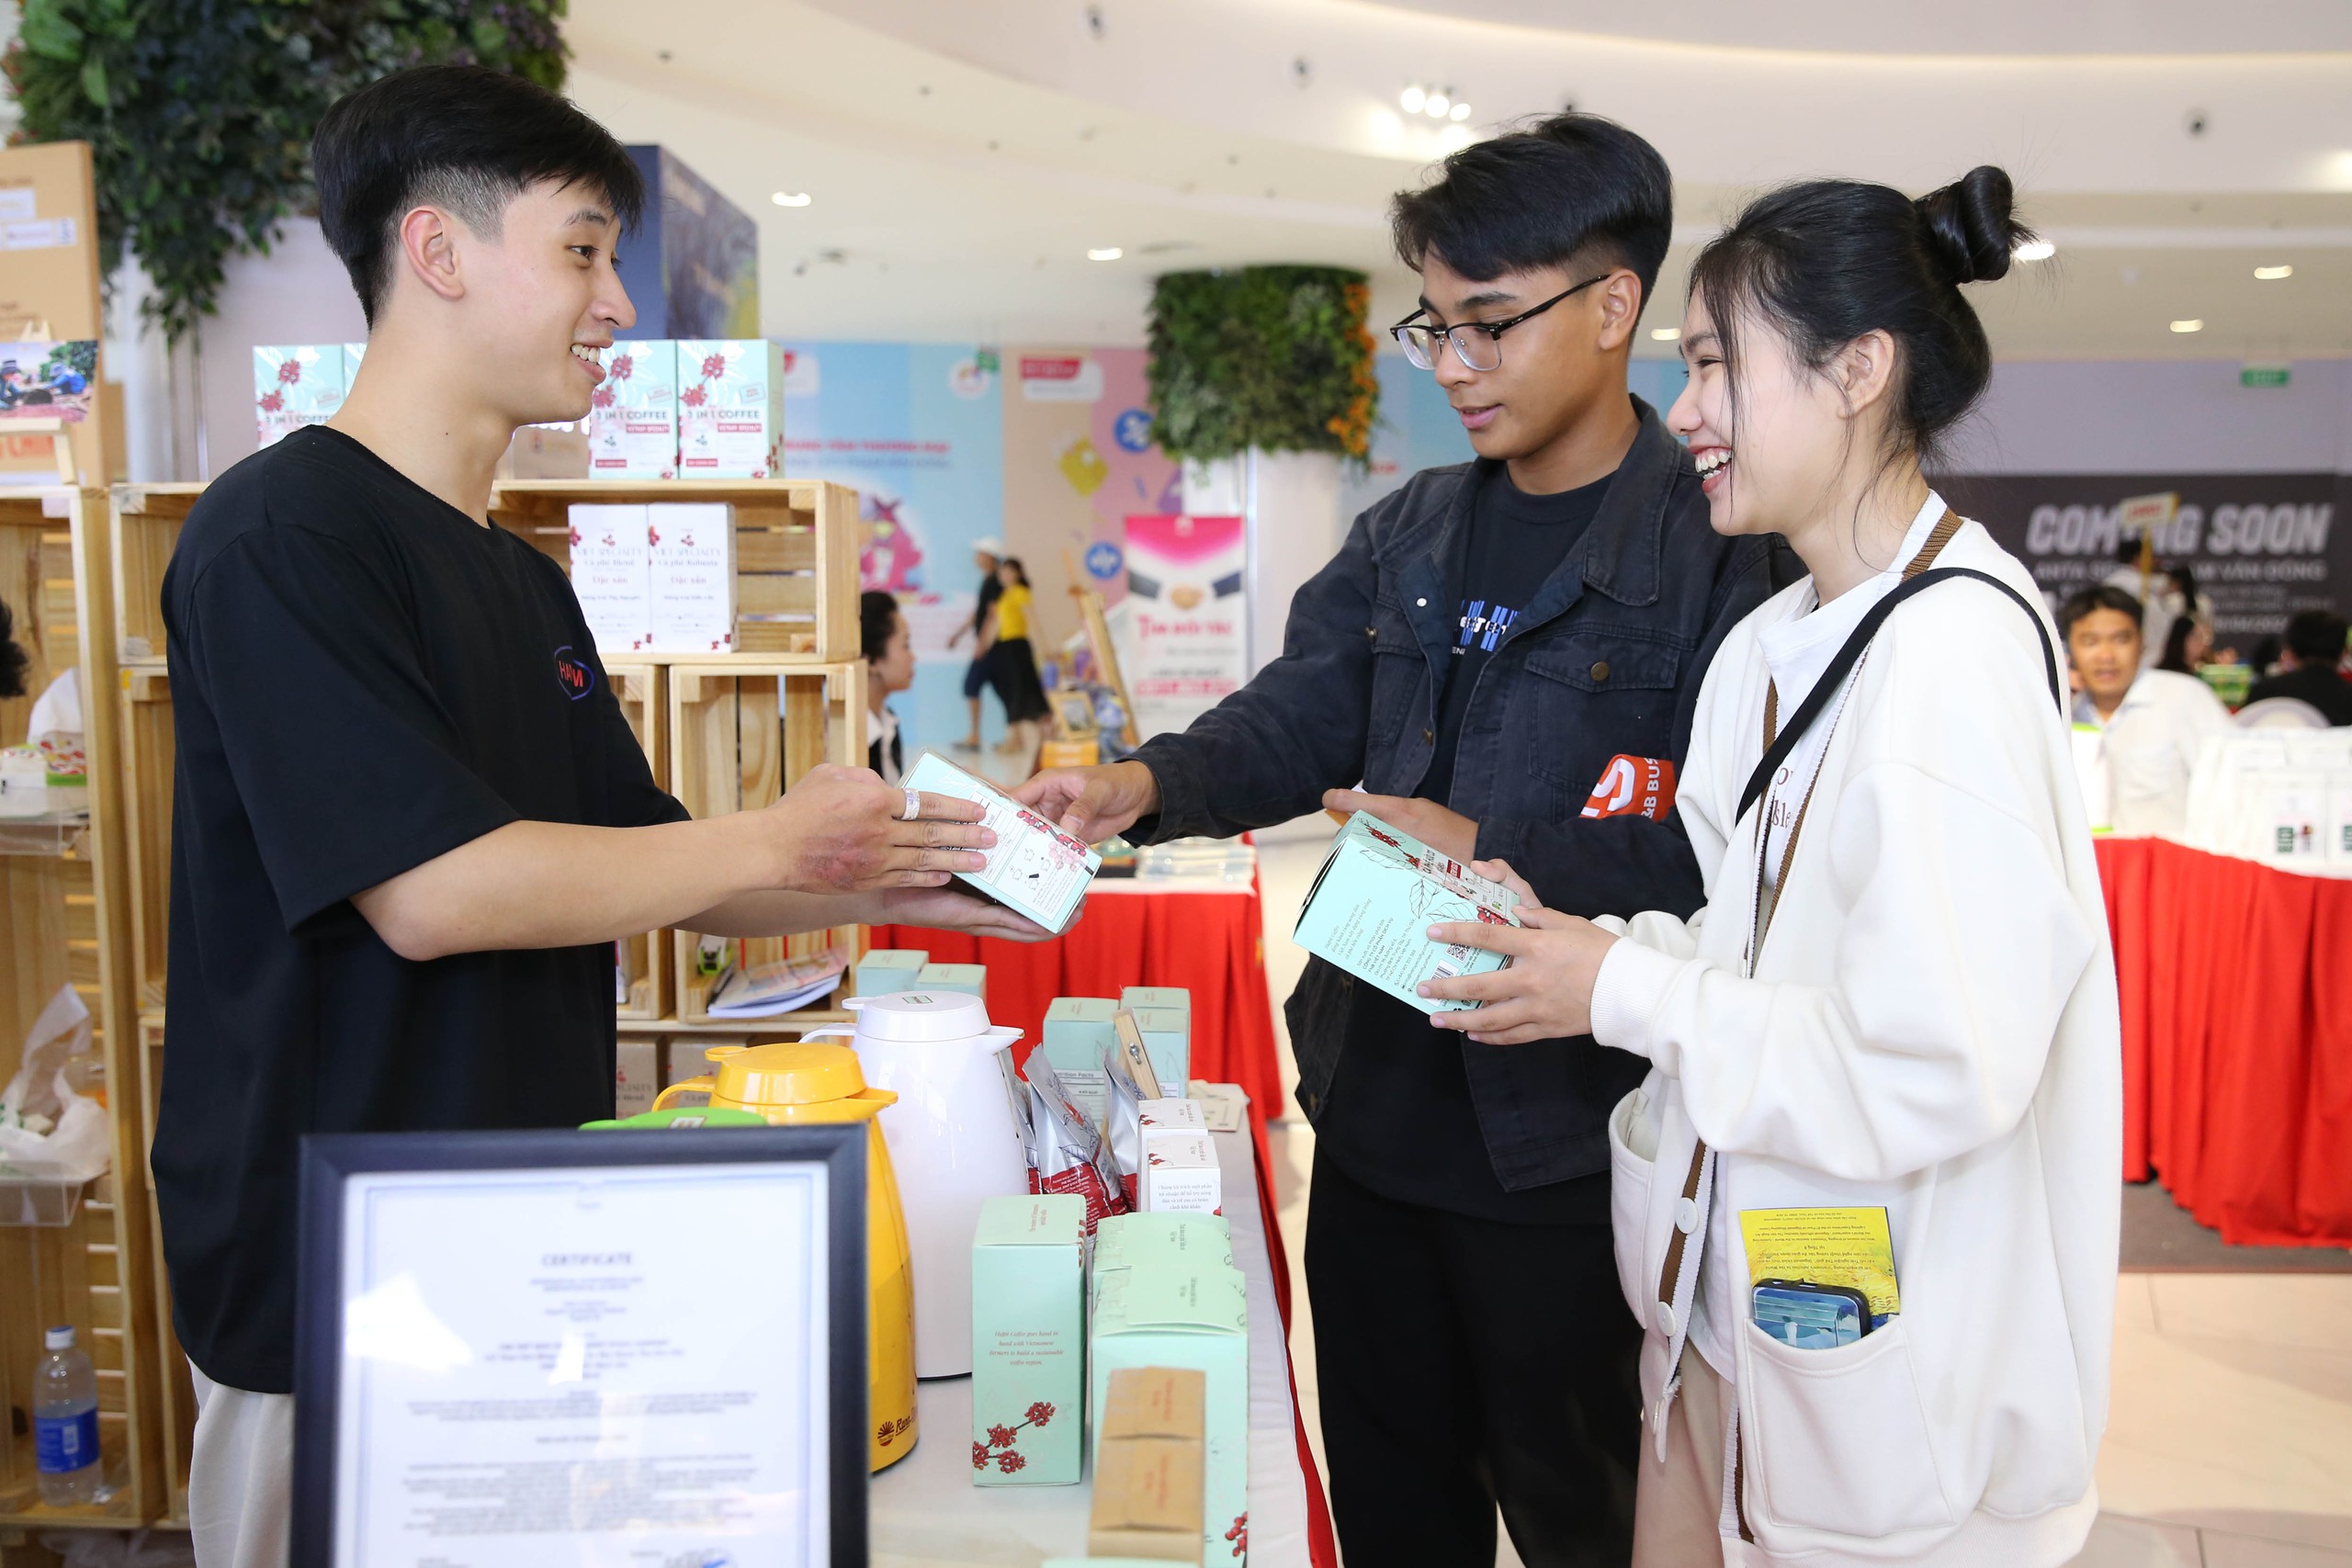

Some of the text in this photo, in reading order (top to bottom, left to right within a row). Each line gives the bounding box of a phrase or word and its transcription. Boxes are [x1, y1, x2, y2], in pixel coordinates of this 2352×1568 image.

[627, 411, 667, 420] COFFEE
[718, 410, 760, 419] COFFEE
[2026, 503, 2335, 556] COMNG SOON
[542, 1251, 632, 1268] CERTIFICATE
